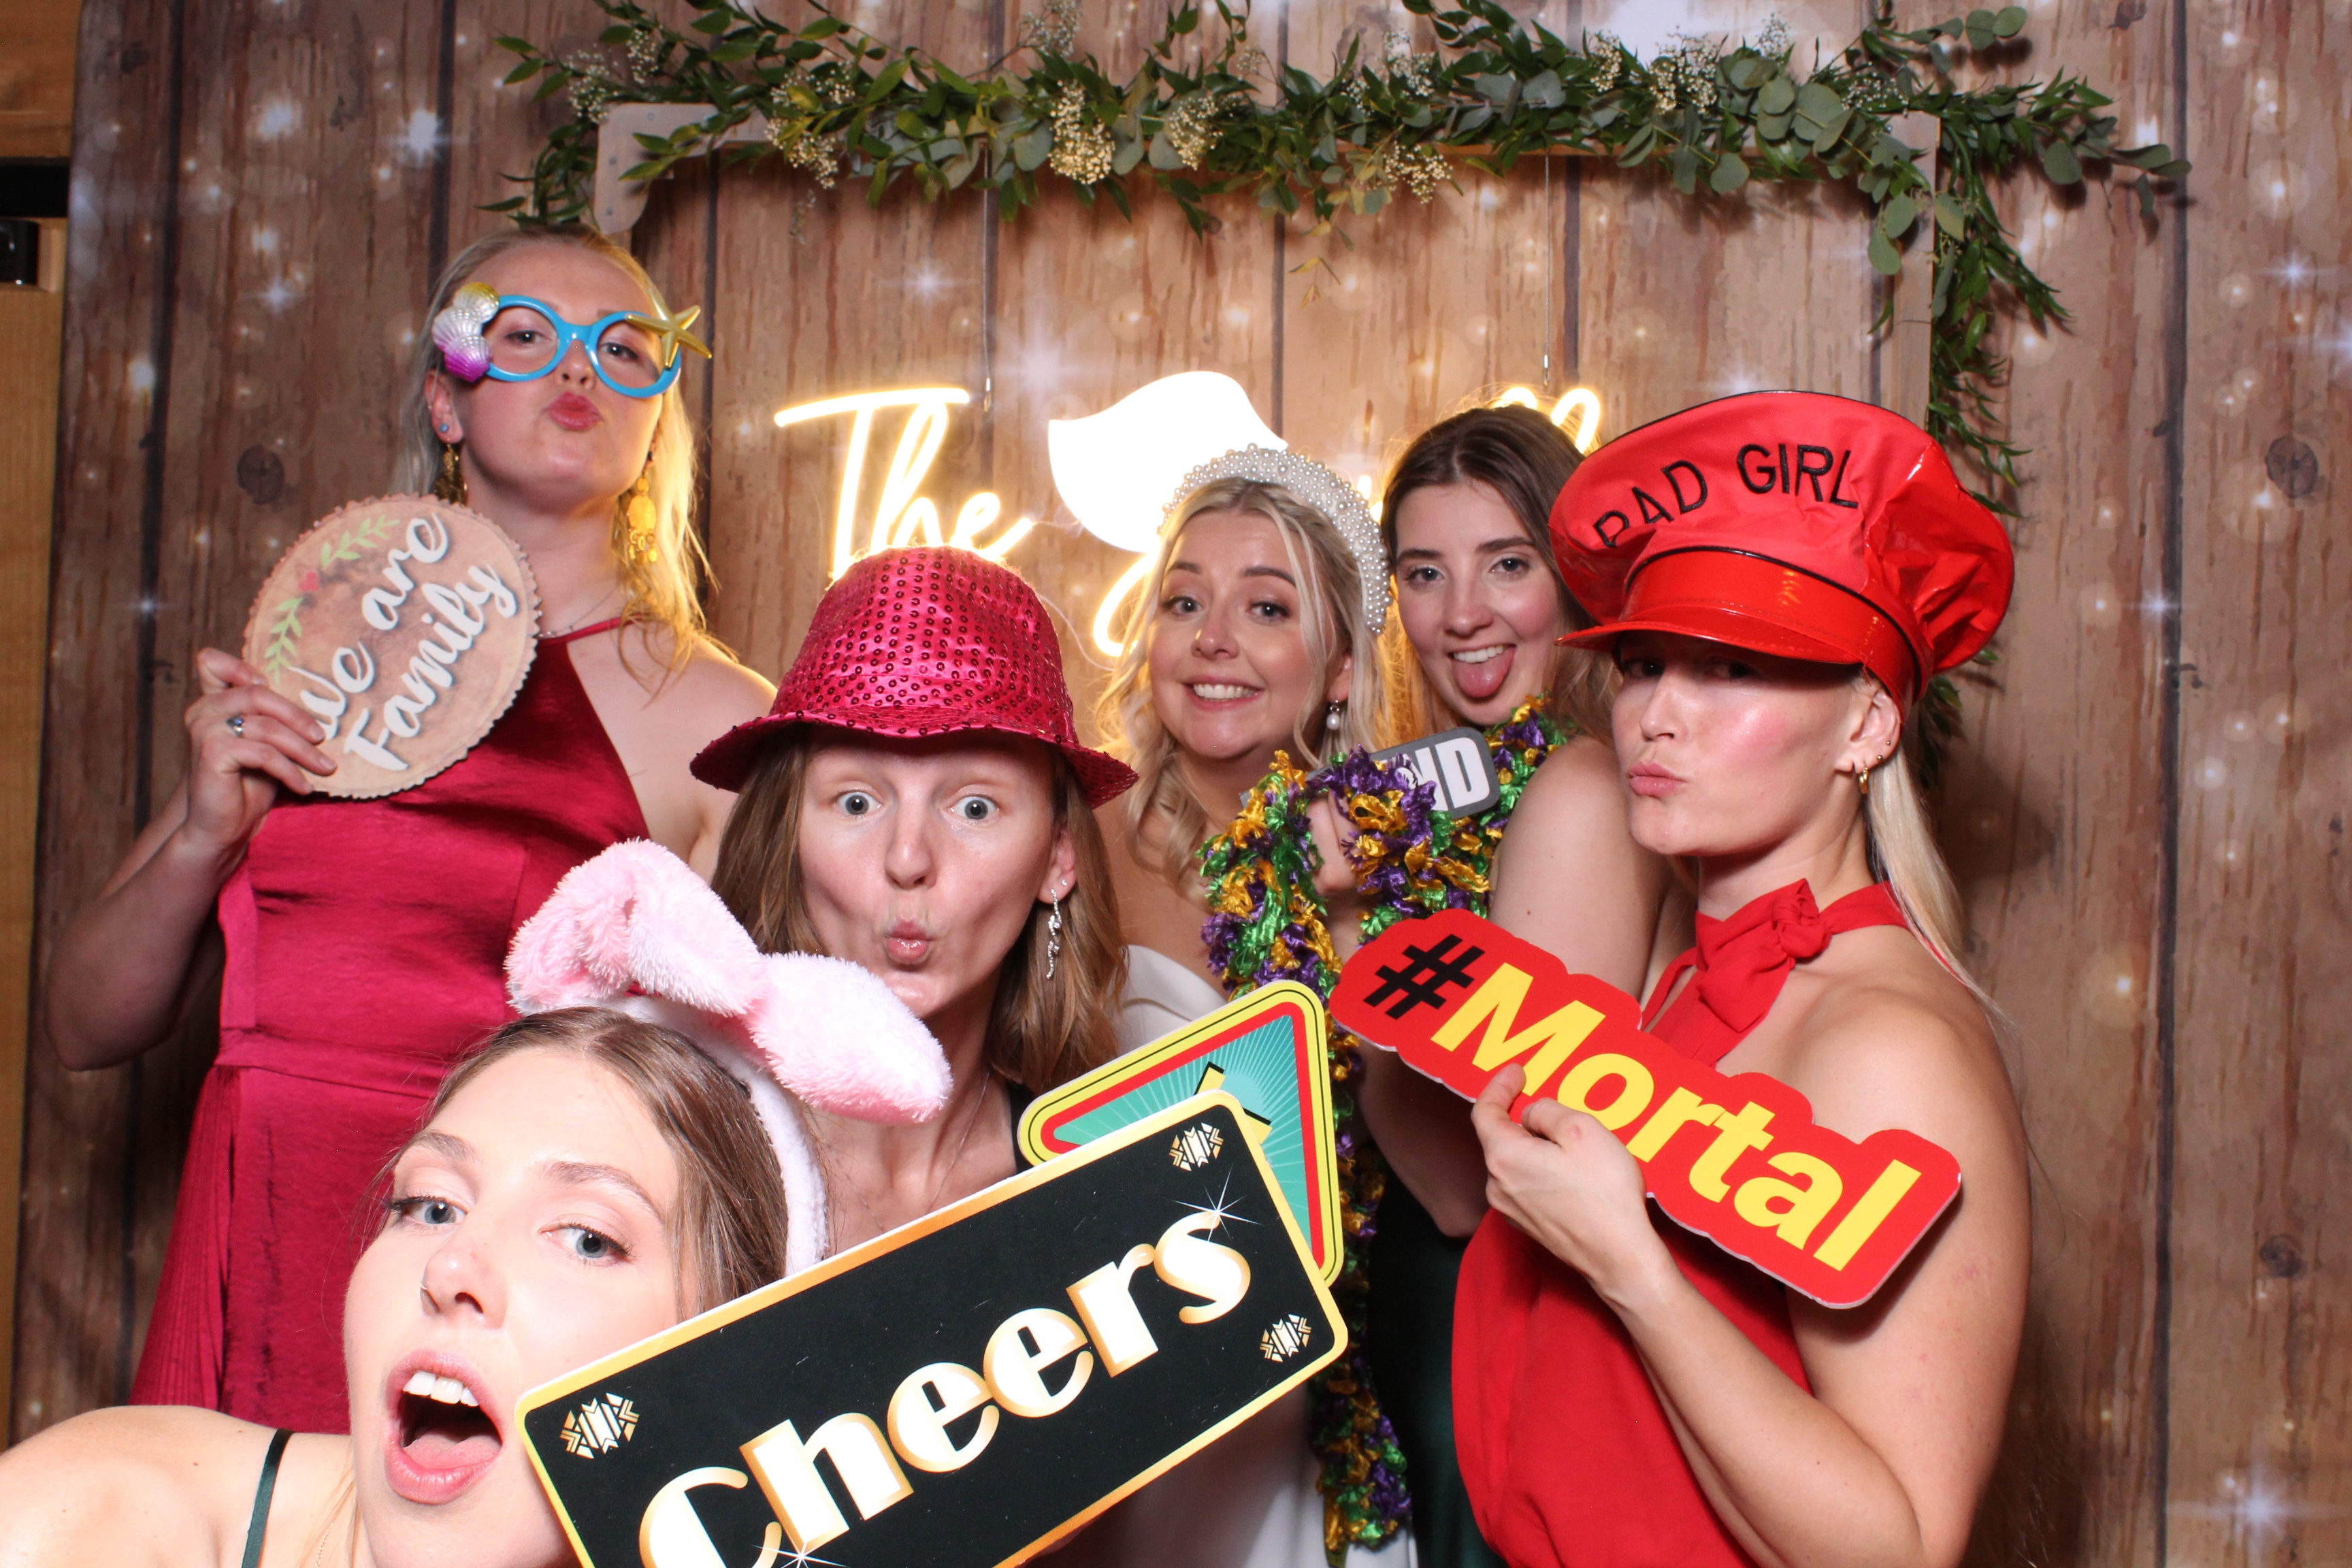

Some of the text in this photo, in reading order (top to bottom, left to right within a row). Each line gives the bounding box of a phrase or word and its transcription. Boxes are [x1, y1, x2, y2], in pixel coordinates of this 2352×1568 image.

[773, 387, 1034, 583] The
[1737, 444, 1859, 509] GIRL
[288, 512, 448, 741] We are
[344, 564, 518, 772] Family
[1362, 933, 1923, 1272] #Mortal
[638, 1210, 1252, 1568] Cheers
